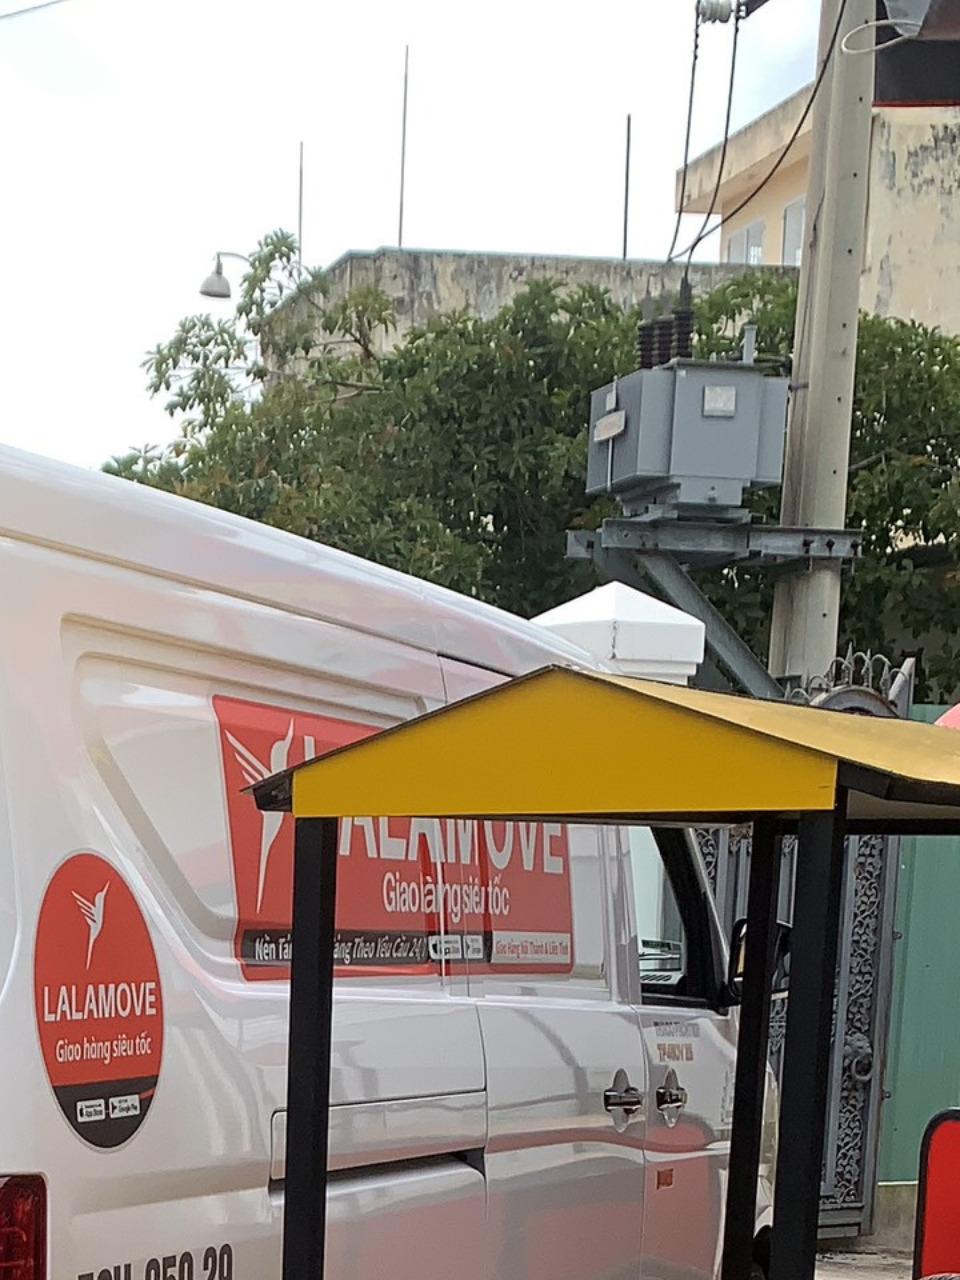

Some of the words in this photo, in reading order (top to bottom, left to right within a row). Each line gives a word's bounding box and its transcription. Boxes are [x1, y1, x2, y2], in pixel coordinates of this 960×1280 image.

[383, 871, 417, 913] Giao
[487, 874, 510, 916] tốc
[44, 982, 156, 1022] LALAMOVE
[56, 1038, 81, 1062] Giao
[83, 1036, 110, 1064] hàng
[112, 1033, 133, 1057] siêu
[135, 1031, 151, 1055] tốc
